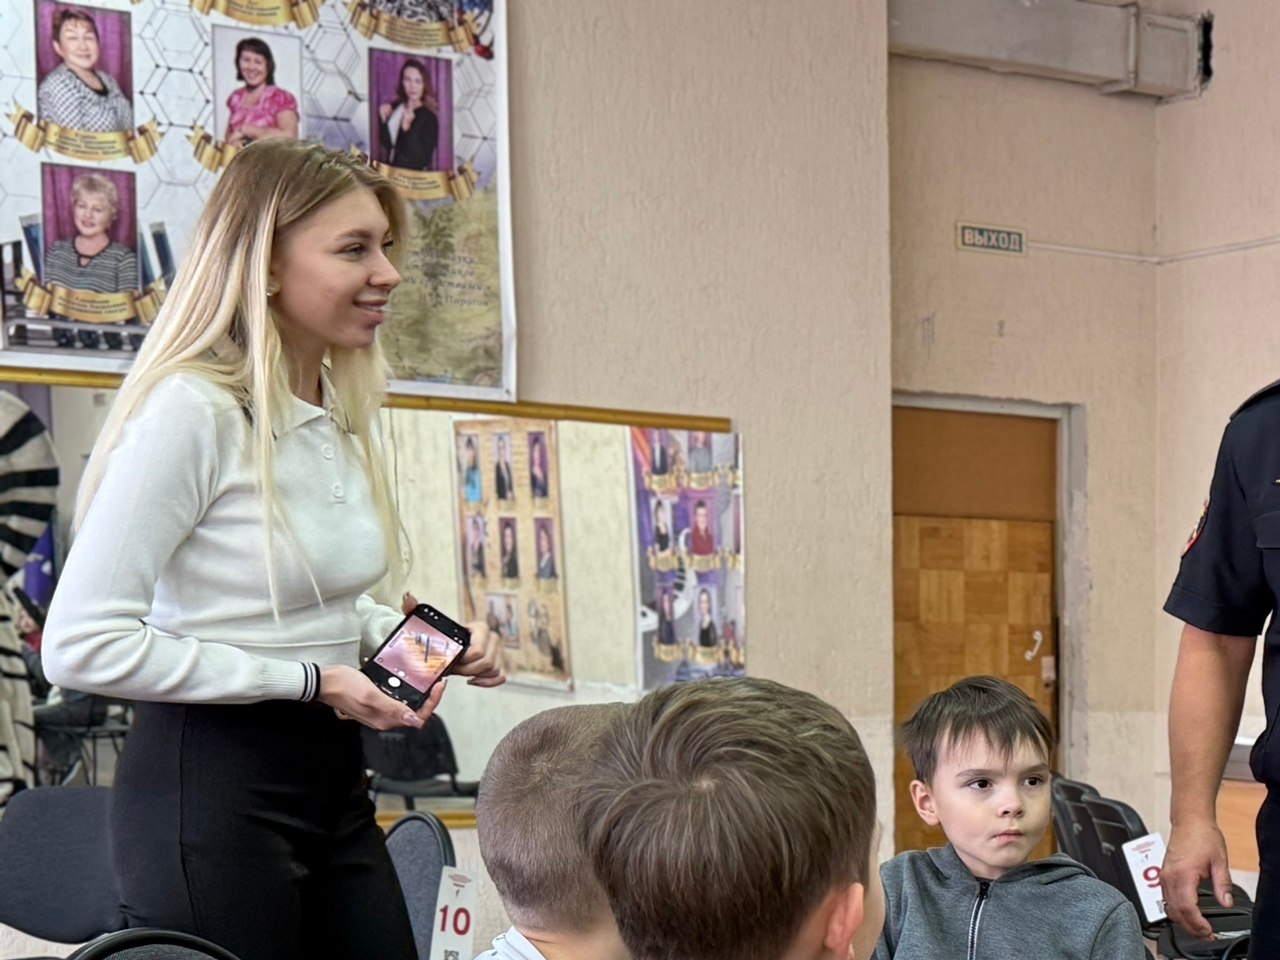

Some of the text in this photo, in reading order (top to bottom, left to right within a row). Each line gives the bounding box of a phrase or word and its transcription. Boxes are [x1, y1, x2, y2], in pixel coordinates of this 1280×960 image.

[963, 228, 1020, 251] ВЫХОД
[1142, 865, 1163, 888] 9
[439, 904, 471, 936] 10
